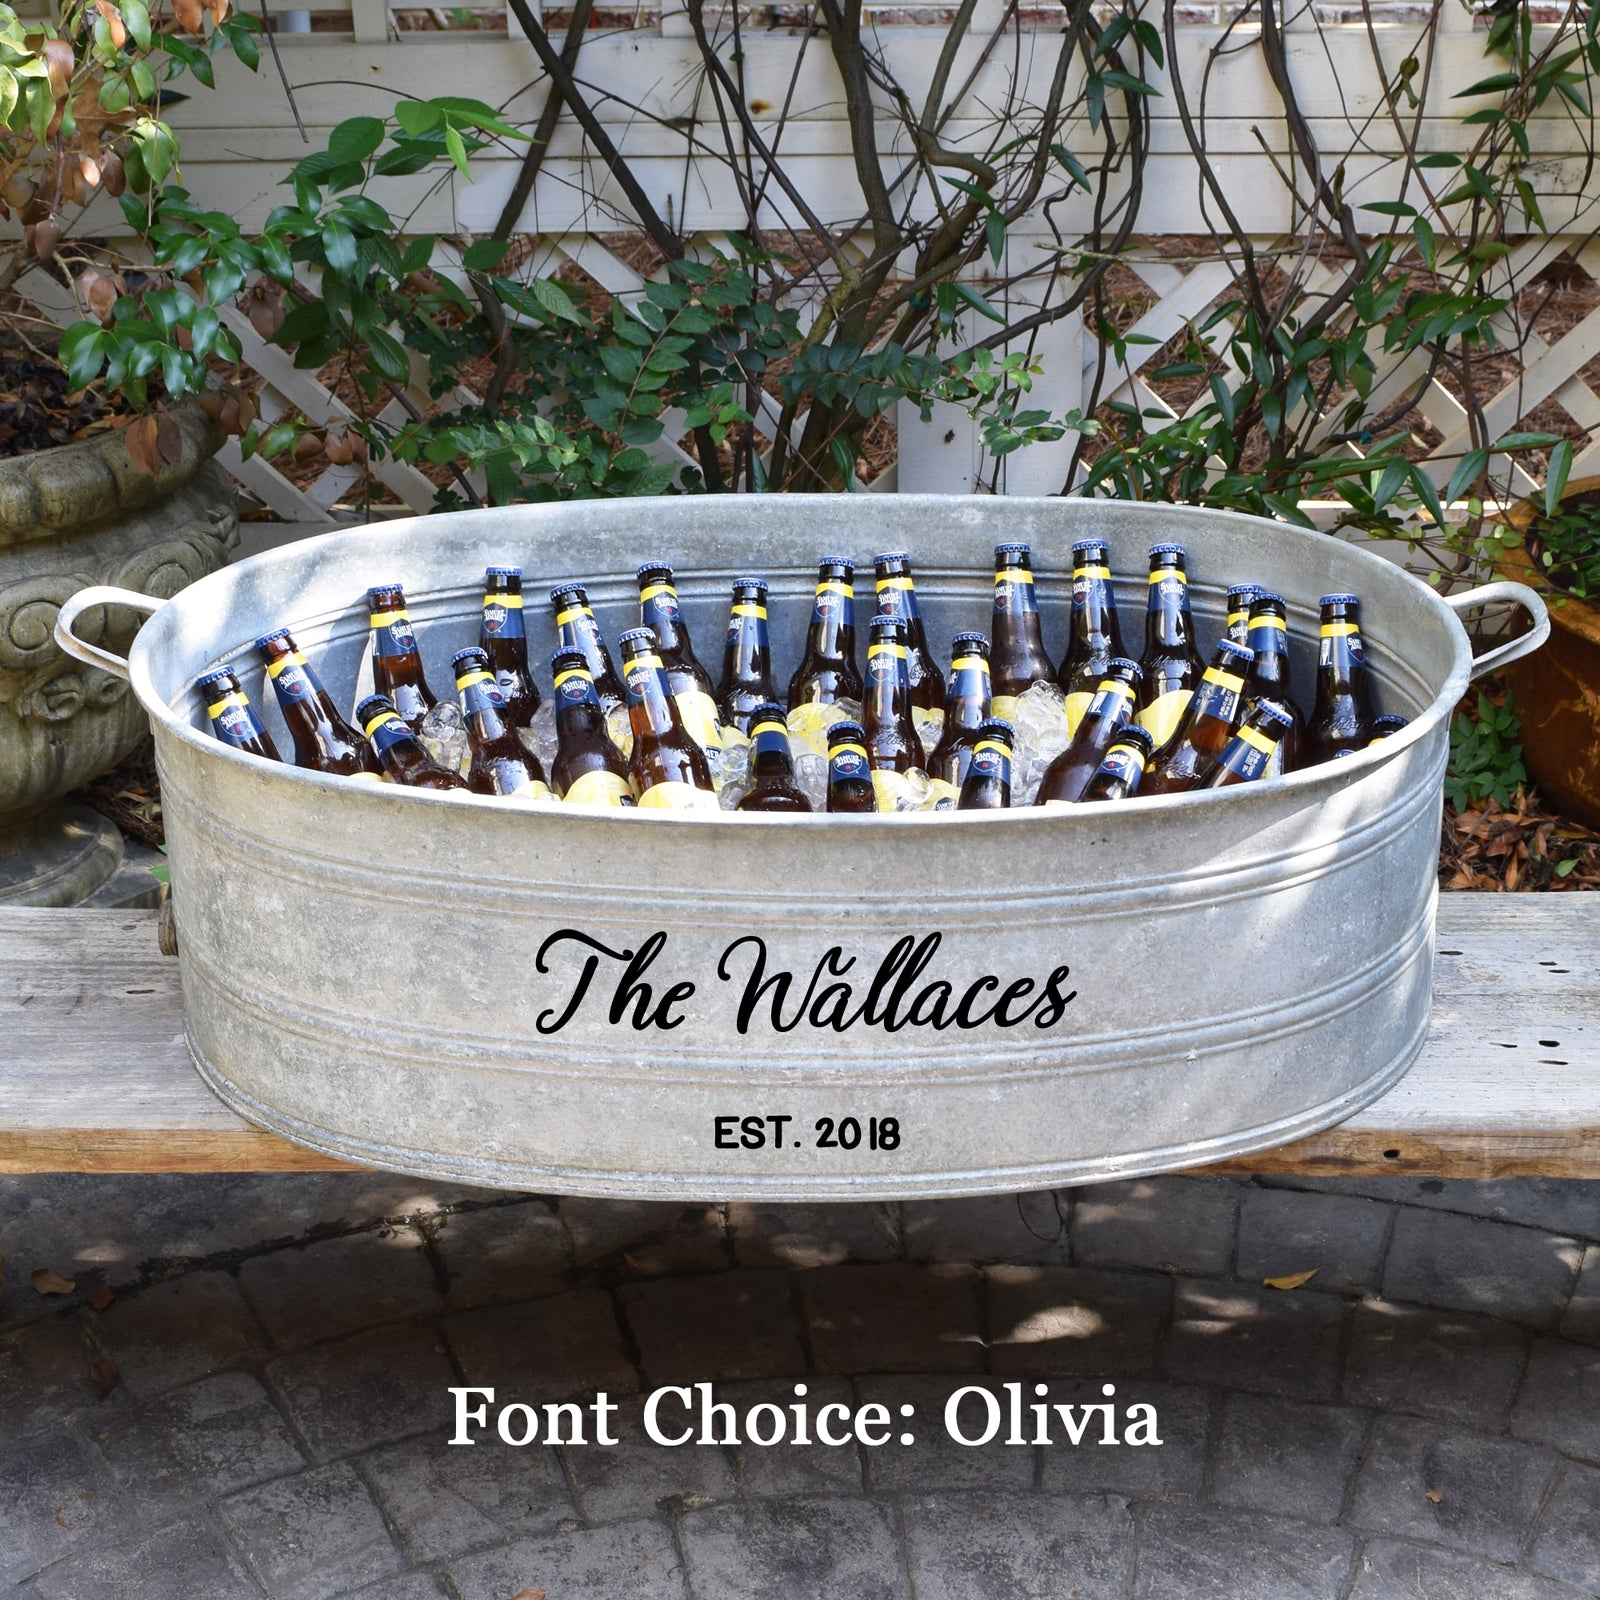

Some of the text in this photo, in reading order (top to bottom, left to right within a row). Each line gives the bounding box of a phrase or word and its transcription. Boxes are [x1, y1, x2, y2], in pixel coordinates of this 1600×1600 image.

[536, 929, 1077, 1034] The Wallaces
[715, 1116, 900, 1150] EST. 2018
